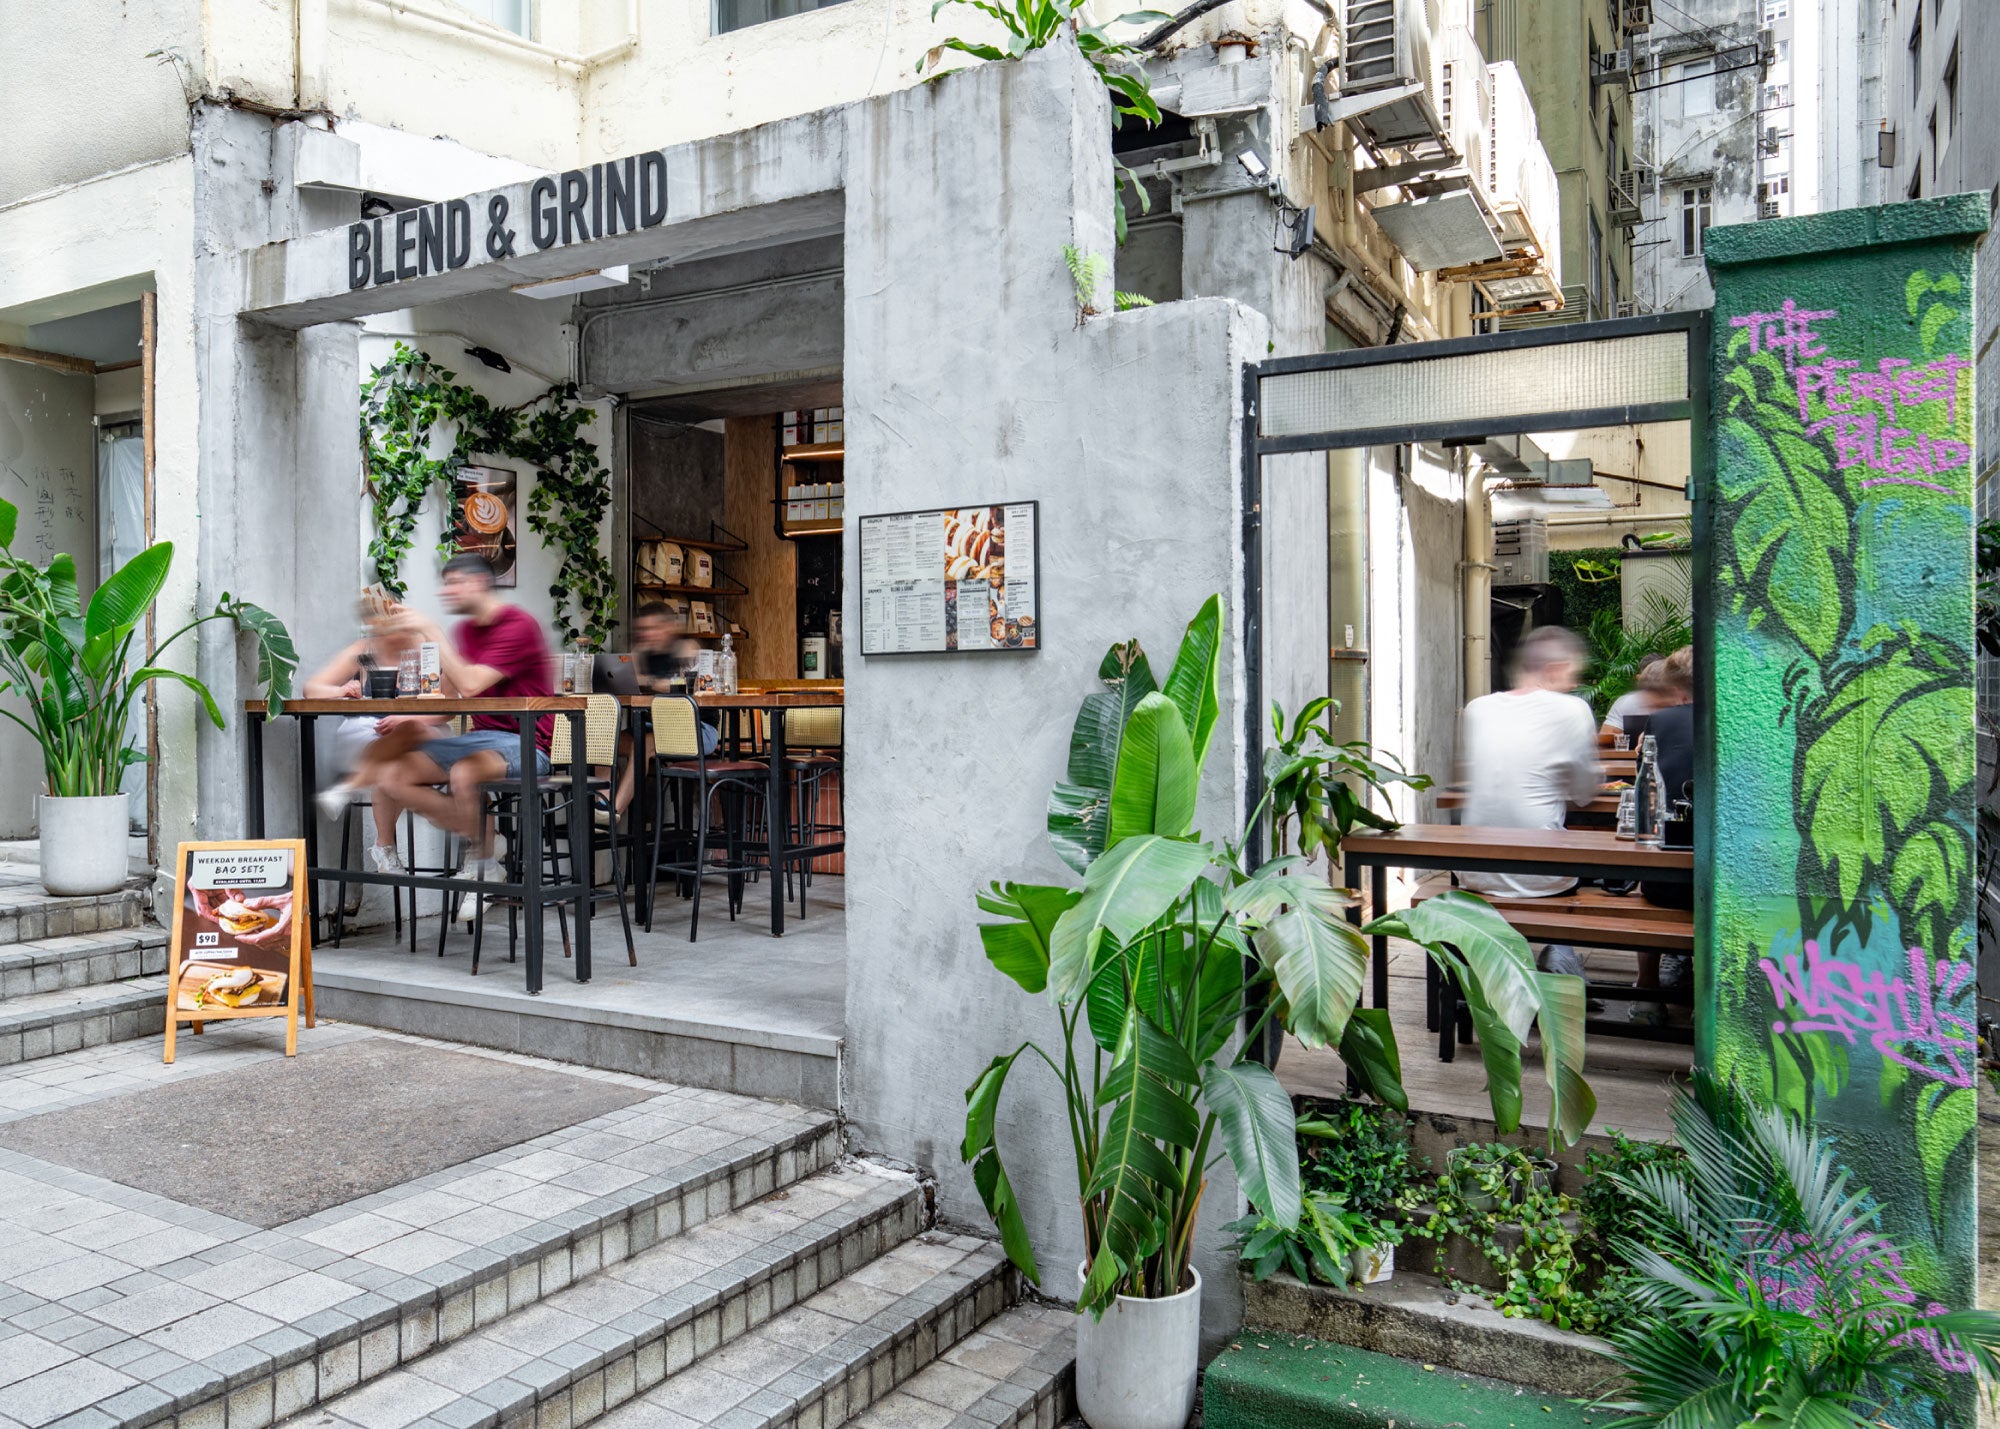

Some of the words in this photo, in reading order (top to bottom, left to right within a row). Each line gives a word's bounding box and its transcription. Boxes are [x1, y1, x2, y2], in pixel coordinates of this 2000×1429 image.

[349, 198, 471, 290] BLEND
[486, 195, 516, 259] &
[531, 150, 668, 250] GRIND
[1729, 299, 1838, 373] THE
[1805, 411, 1973, 475] BLEND
[215, 865, 237, 874] BAO
[241, 865, 265, 874] SETS
[198, 934, 217, 944] $98
